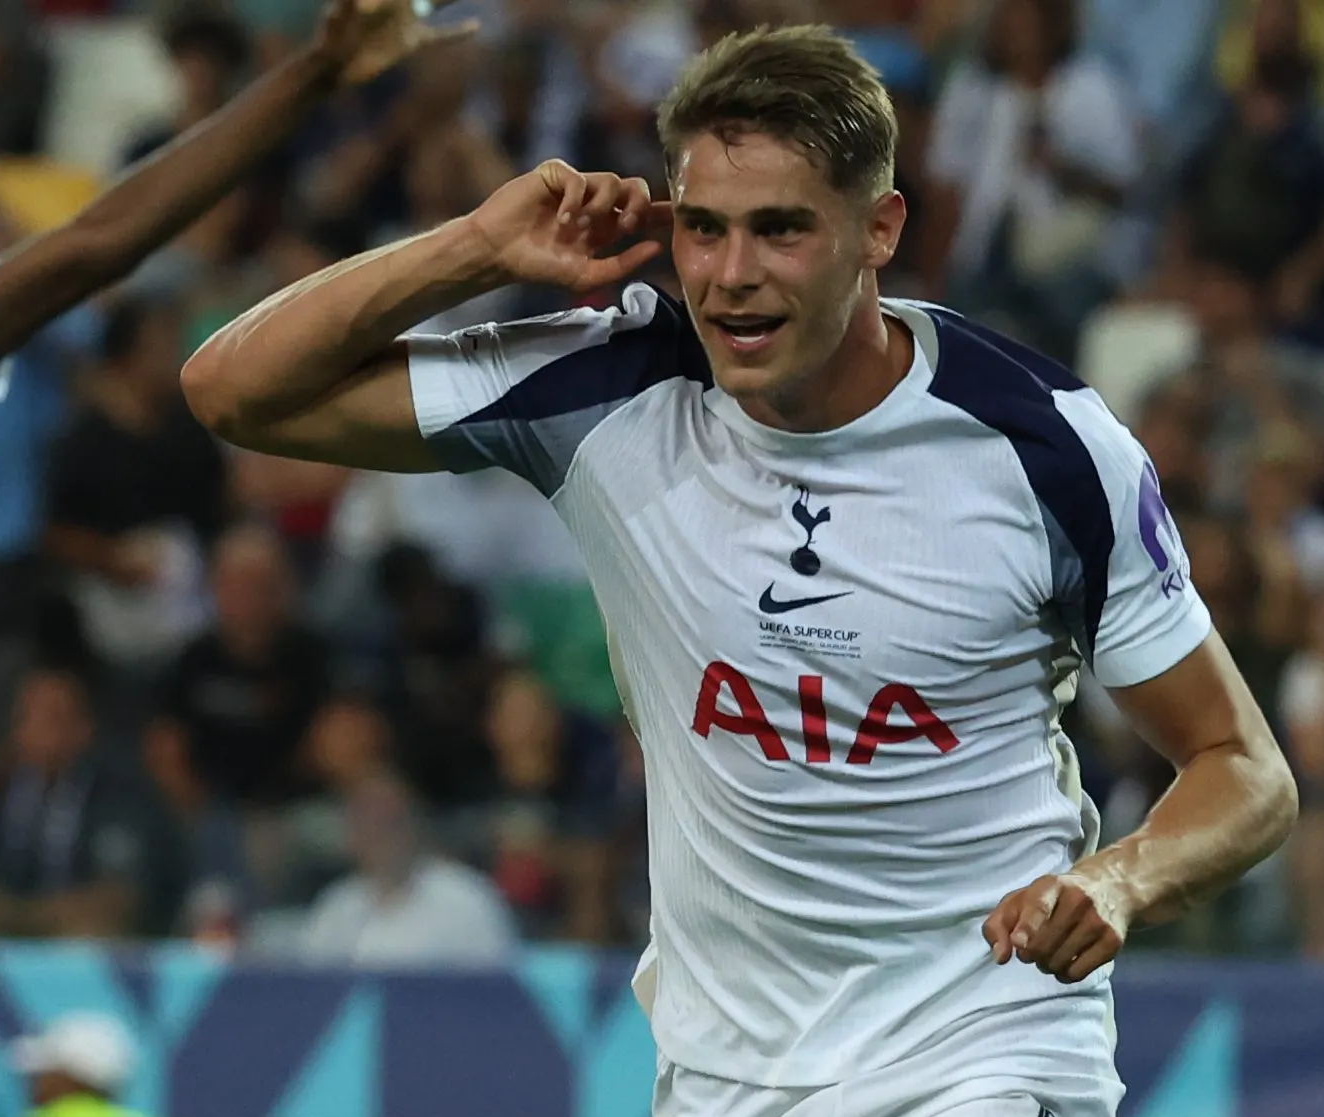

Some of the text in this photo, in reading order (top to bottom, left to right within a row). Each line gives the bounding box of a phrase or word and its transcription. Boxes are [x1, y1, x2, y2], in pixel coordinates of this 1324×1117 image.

[759, 621, 791, 635] UEFA
[793, 625, 832, 640] SUPER
[834, 629, 858, 642] CUP
[692, 660, 959, 764] AIA
